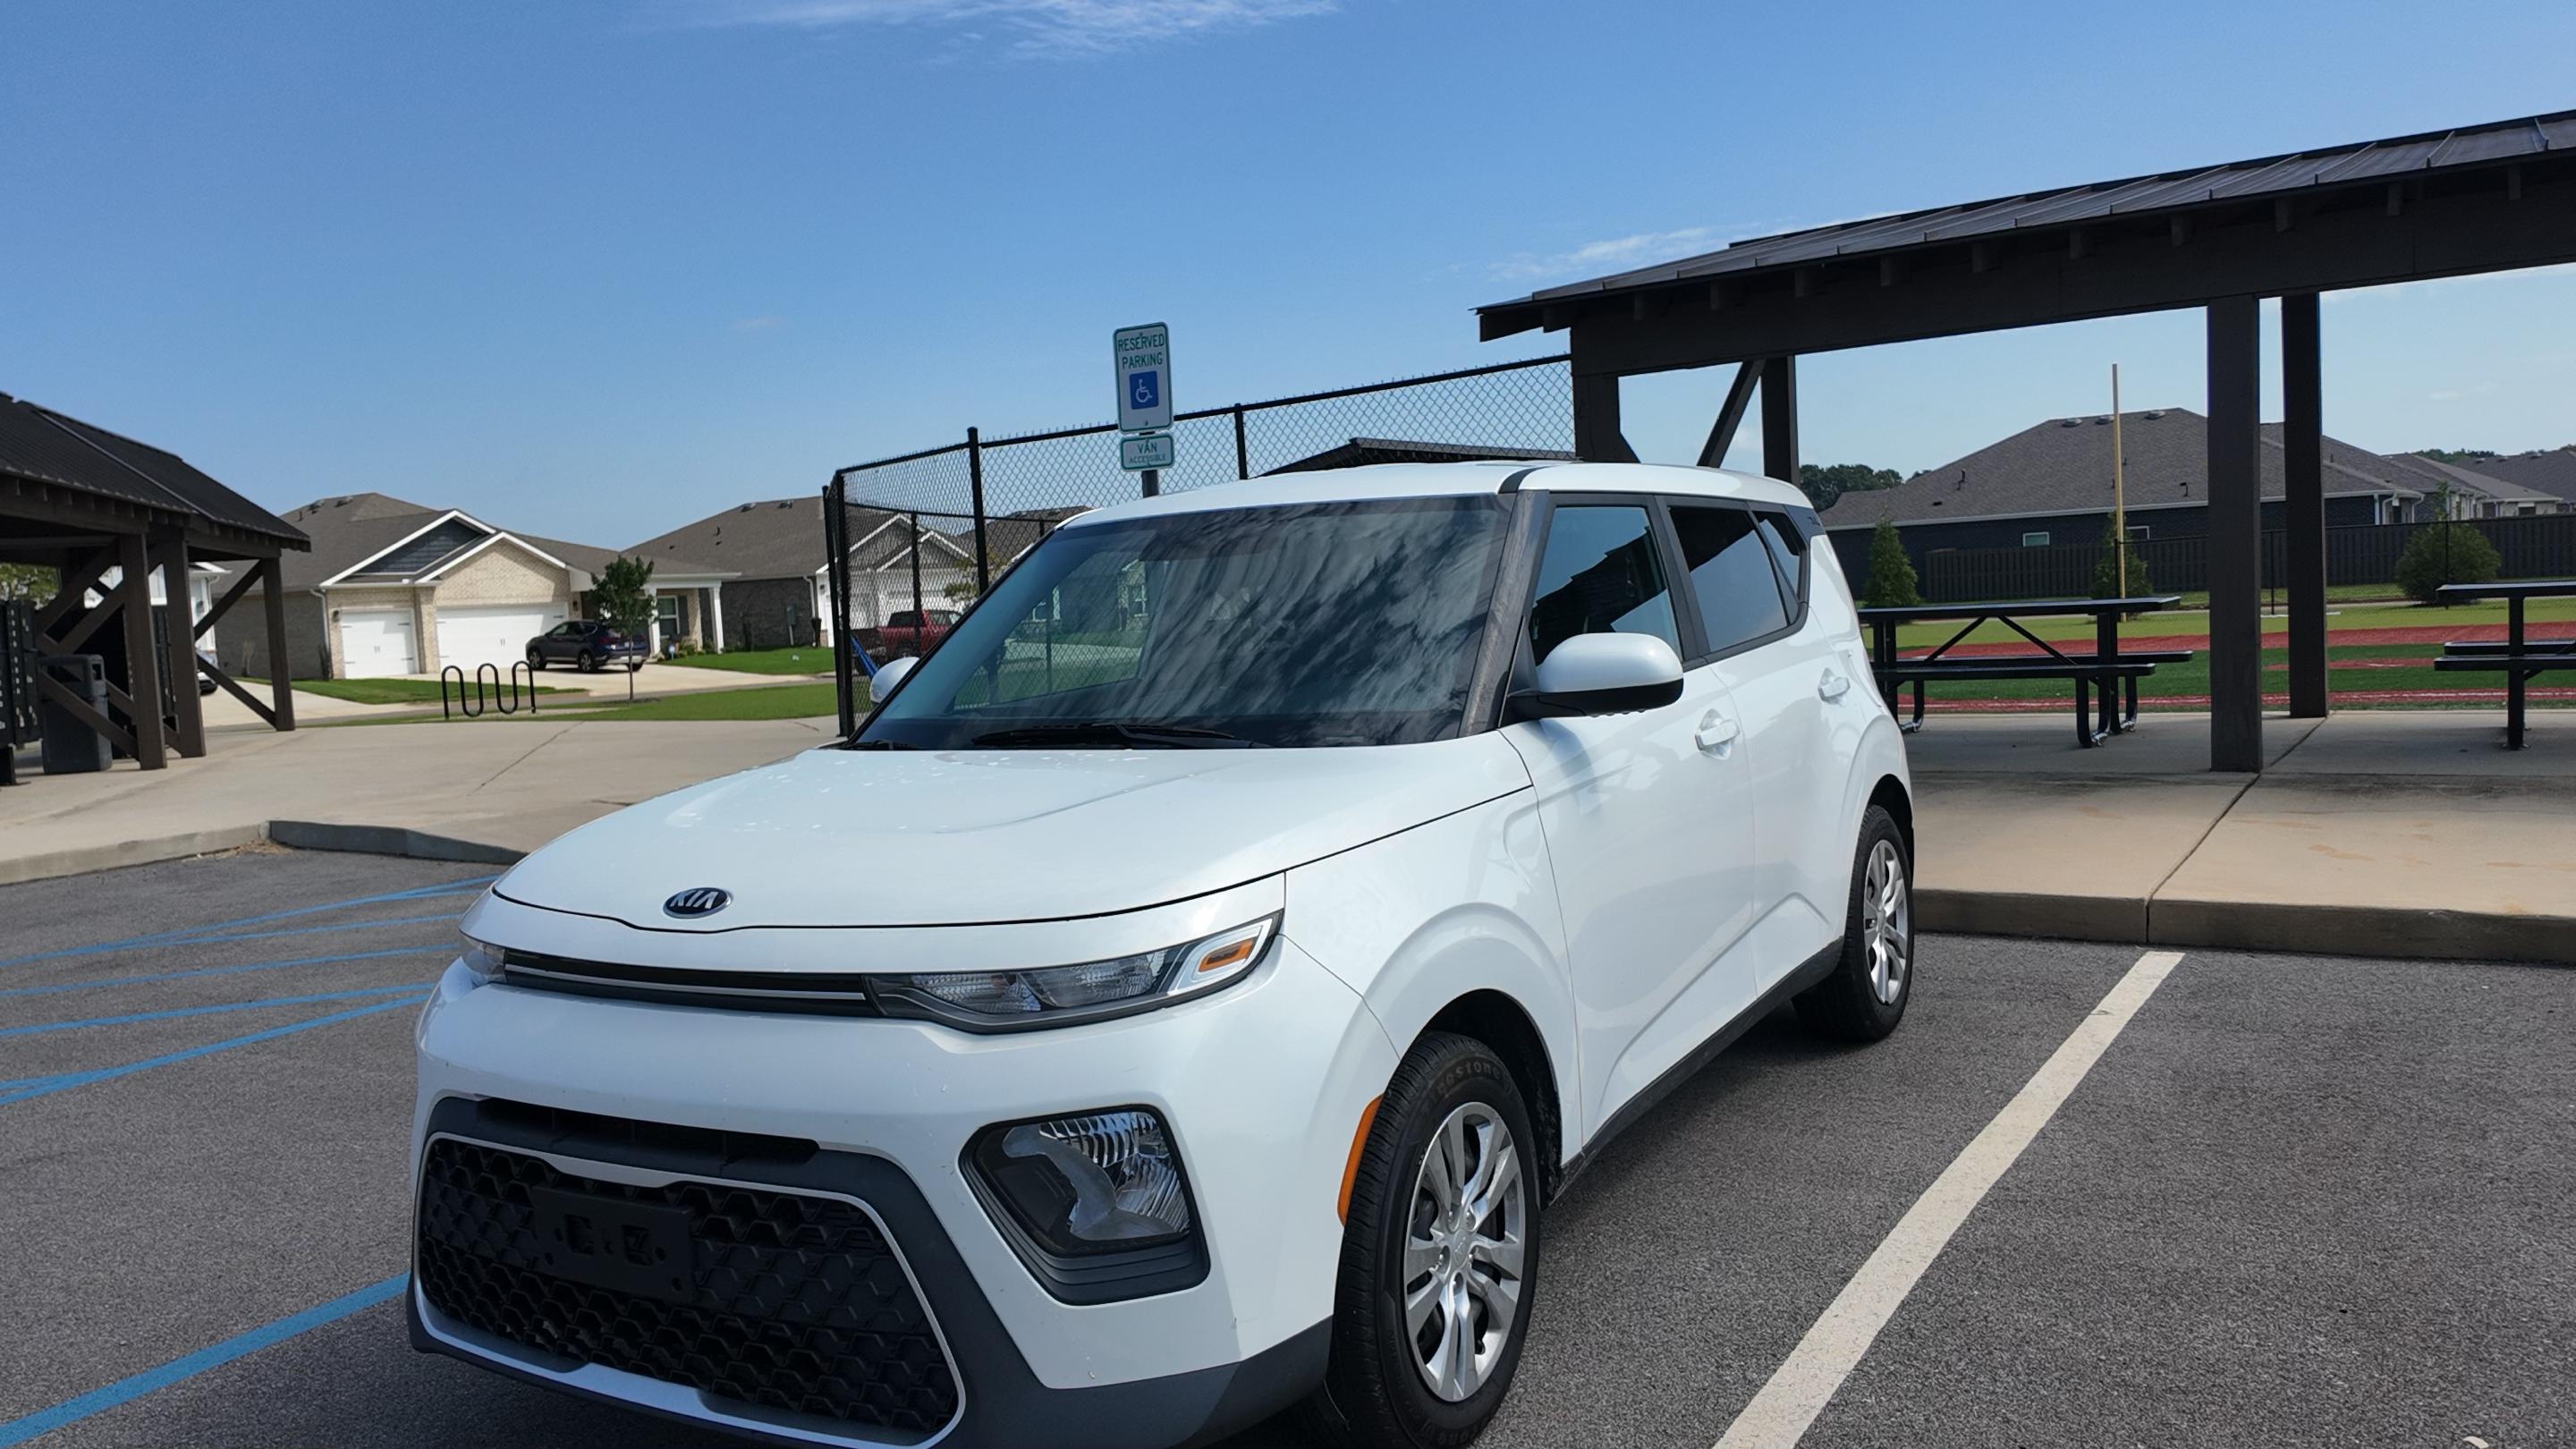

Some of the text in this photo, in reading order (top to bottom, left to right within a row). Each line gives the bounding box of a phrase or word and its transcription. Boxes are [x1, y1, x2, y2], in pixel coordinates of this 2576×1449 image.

[1118, 333, 1165, 352] RESERVED
[1123, 352, 1163, 369] PARKING
[1138, 442, 1157, 453] VAN
[1129, 453, 1166, 464] ACCESSIBLE
[669, 890, 719, 910] KIA
